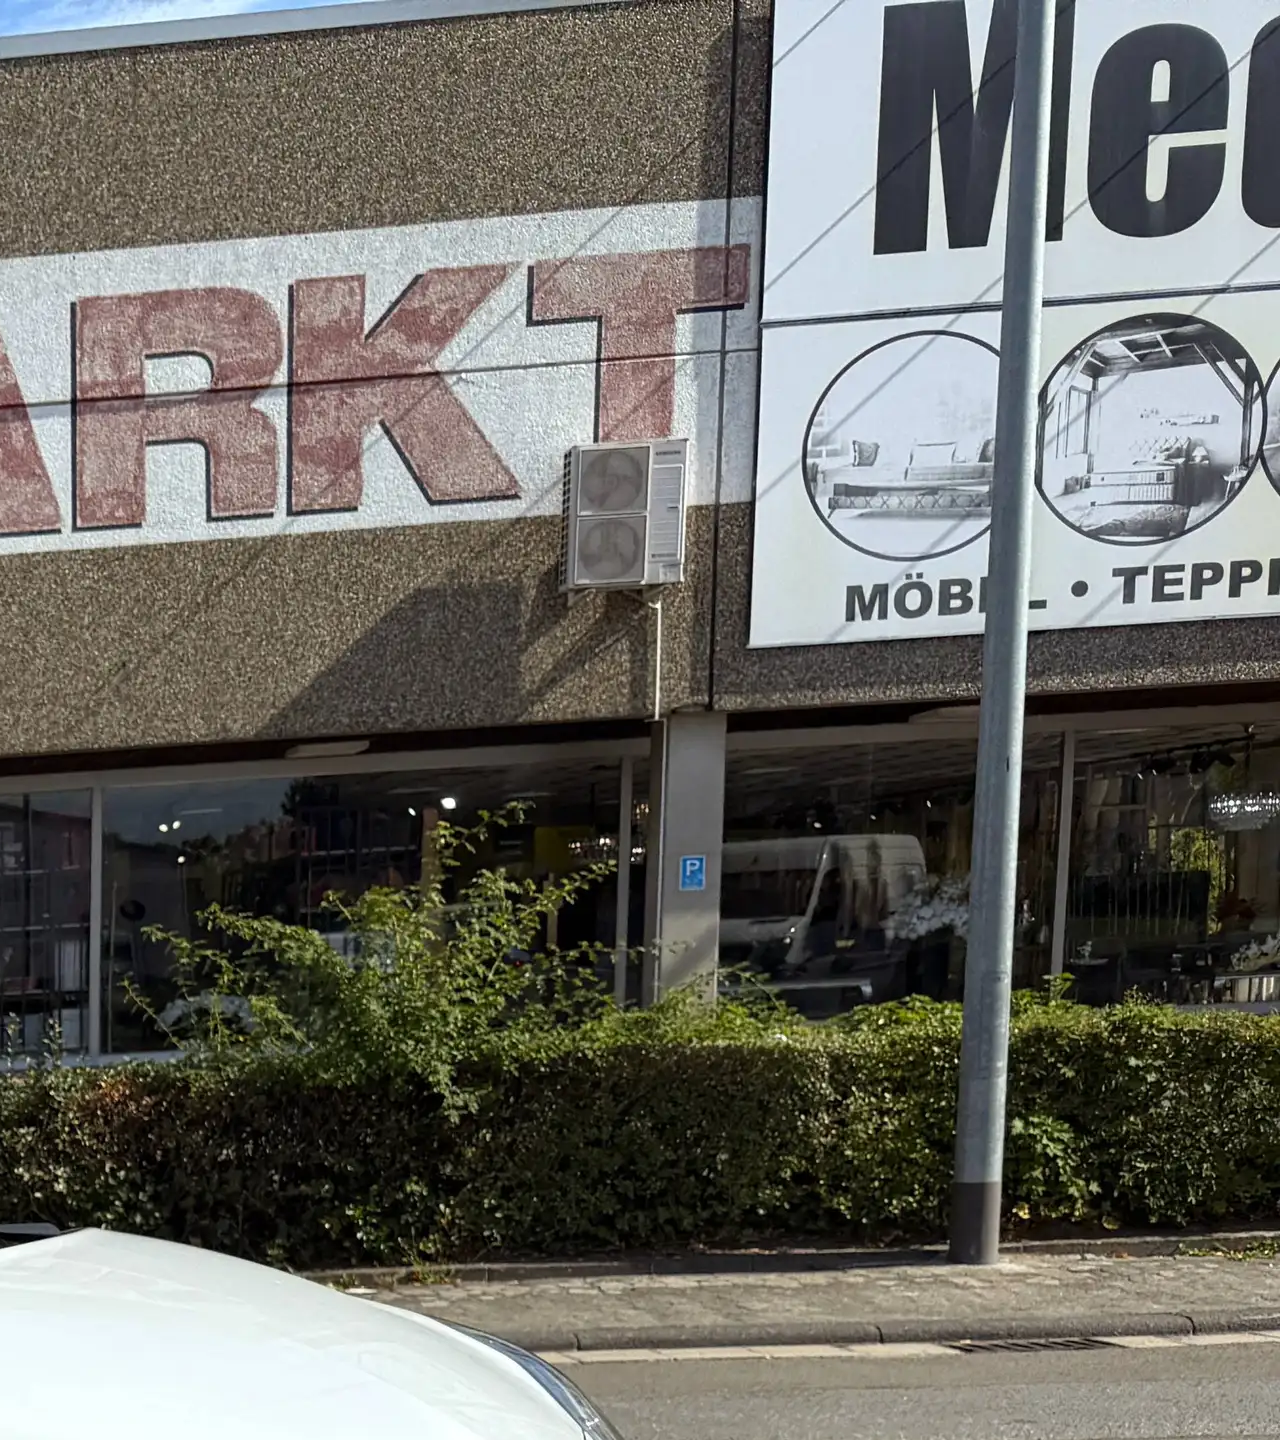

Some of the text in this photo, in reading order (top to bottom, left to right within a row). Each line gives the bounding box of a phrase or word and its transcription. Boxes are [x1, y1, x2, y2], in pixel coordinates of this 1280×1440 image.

[873, 0, 1280, 255] Me
[845, 572, 1048, 622] MÖB
[685, 859, 700, 877] P
